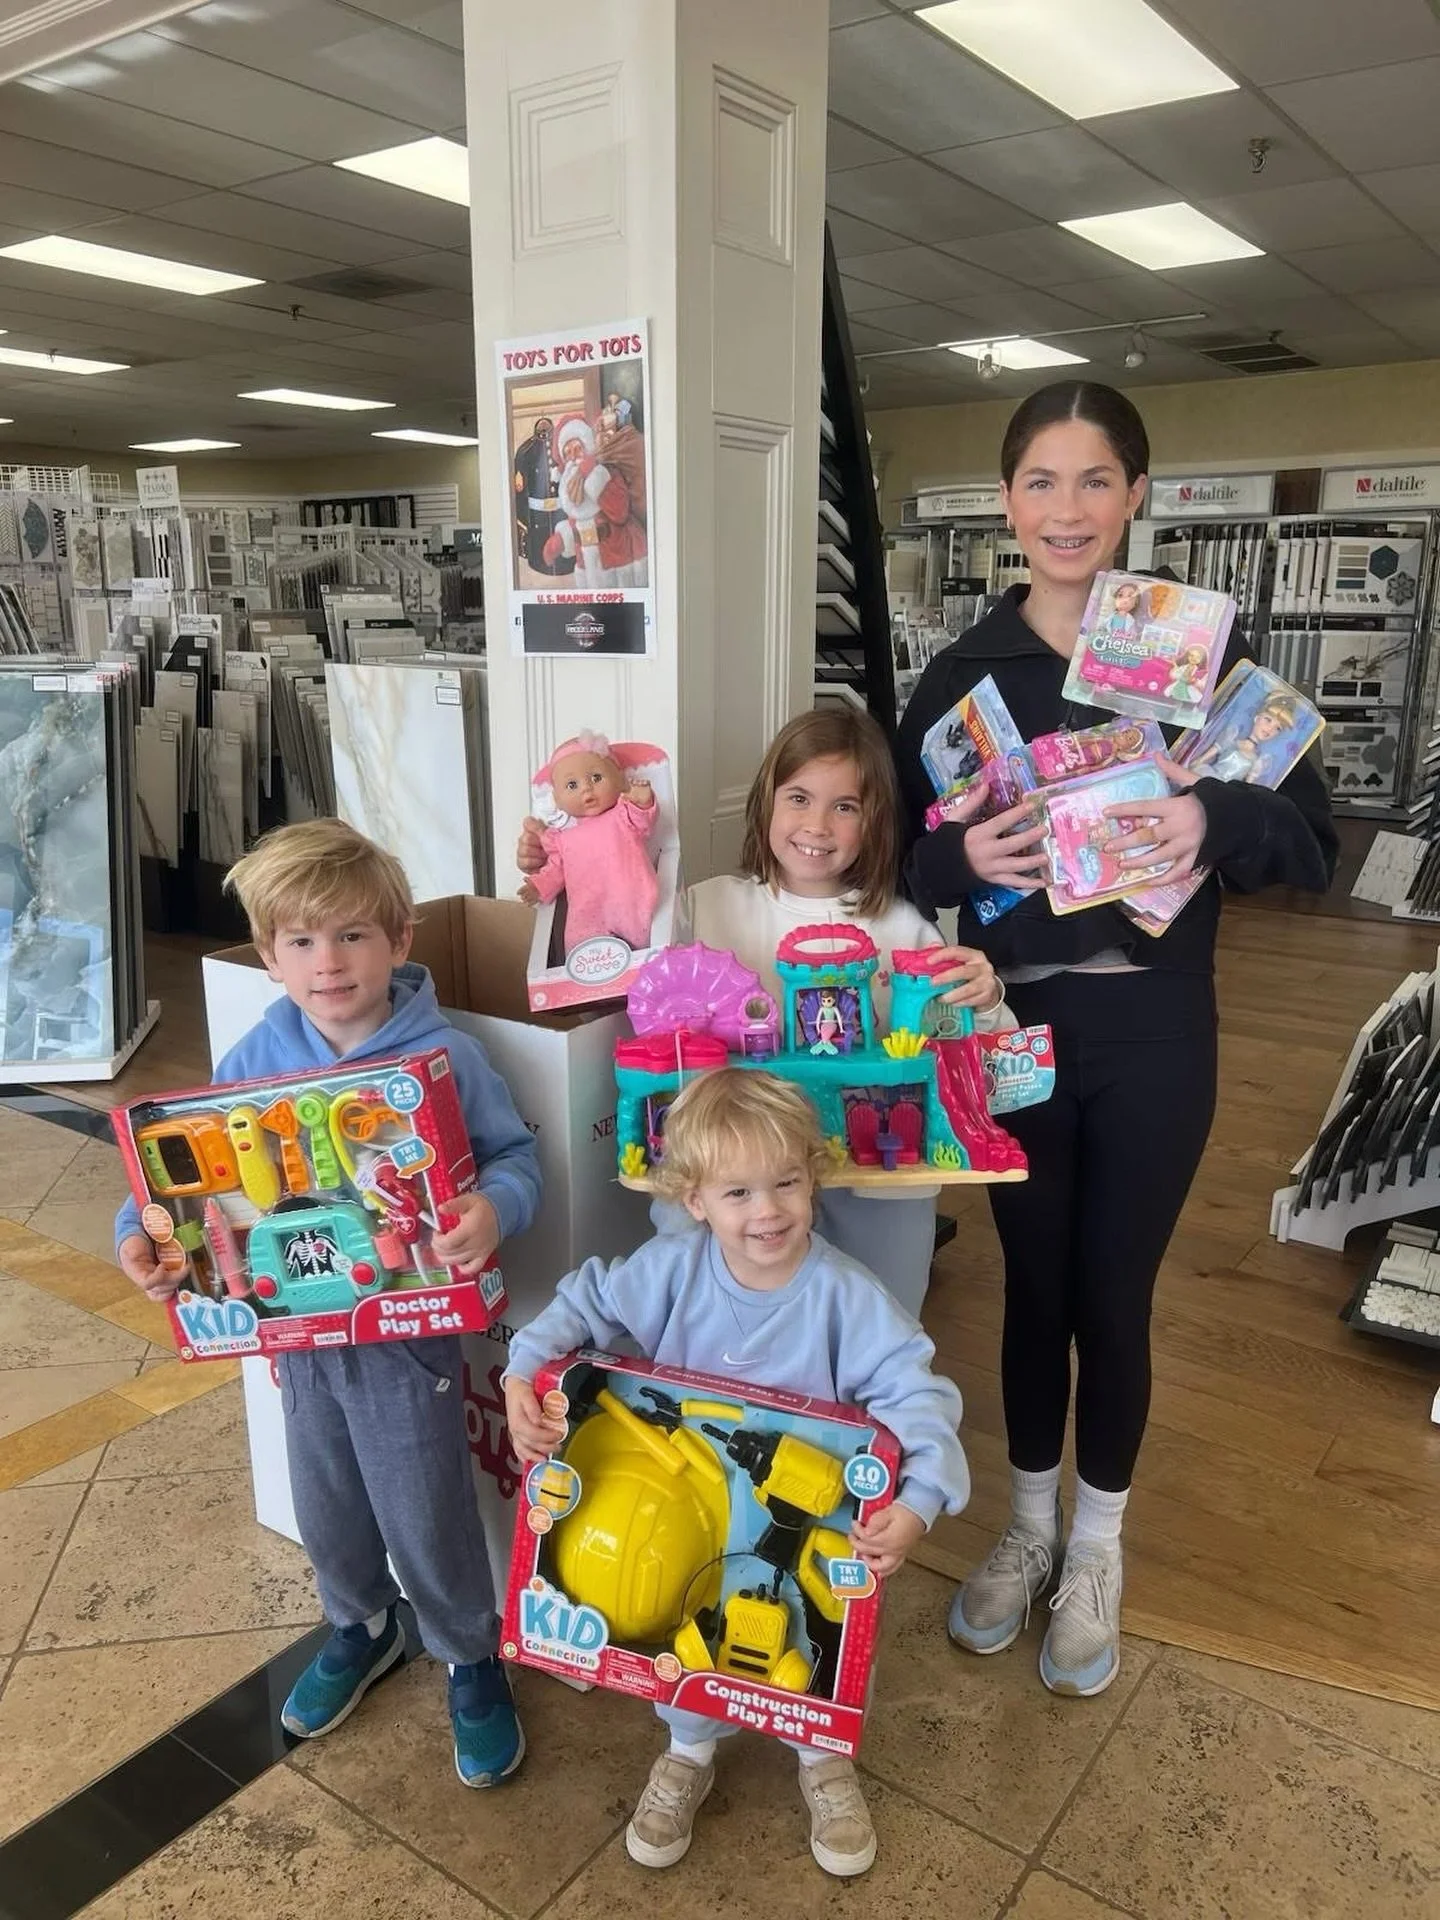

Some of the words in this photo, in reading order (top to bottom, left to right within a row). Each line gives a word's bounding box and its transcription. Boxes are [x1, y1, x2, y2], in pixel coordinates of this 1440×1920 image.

[503, 349, 548, 371] TOYS
[553, 342, 594, 365] FOR
[598, 333, 642, 358] TOTS
[1193, 484, 1238, 500] daltile
[1373, 475, 1425, 492] daltile
[1091, 635, 1150, 657] Chelsea
[575, 946, 624, 974] Sweet
[996, 1053, 1035, 1076] KID
[391, 1082, 415, 1099] 25
[592, 1115, 617, 1142] NE
[399, 1144, 416, 1156] TRY
[482, 1270, 503, 1302] KID
[380, 1296, 450, 1316] Doctor
[179, 1303, 255, 1341] KID
[378, 1317, 421, 1336] Play
[429, 1313, 463, 1331] Set
[196, 1339, 258, 1354] Connection
[855, 1463, 881, 1484] 10
[853, 1481, 880, 1492] PIECES
[838, 1565, 859, 1575] TRY
[840, 1575, 860, 1585] ME!
[525, 1594, 604, 1650] KID
[525, 1639, 597, 1667] Connection
[621, 1671, 656, 1689] WARNING
[704, 1679, 832, 1726] Construction
[727, 1702, 768, 1729] Play
[773, 1717, 806, 1736] Set
